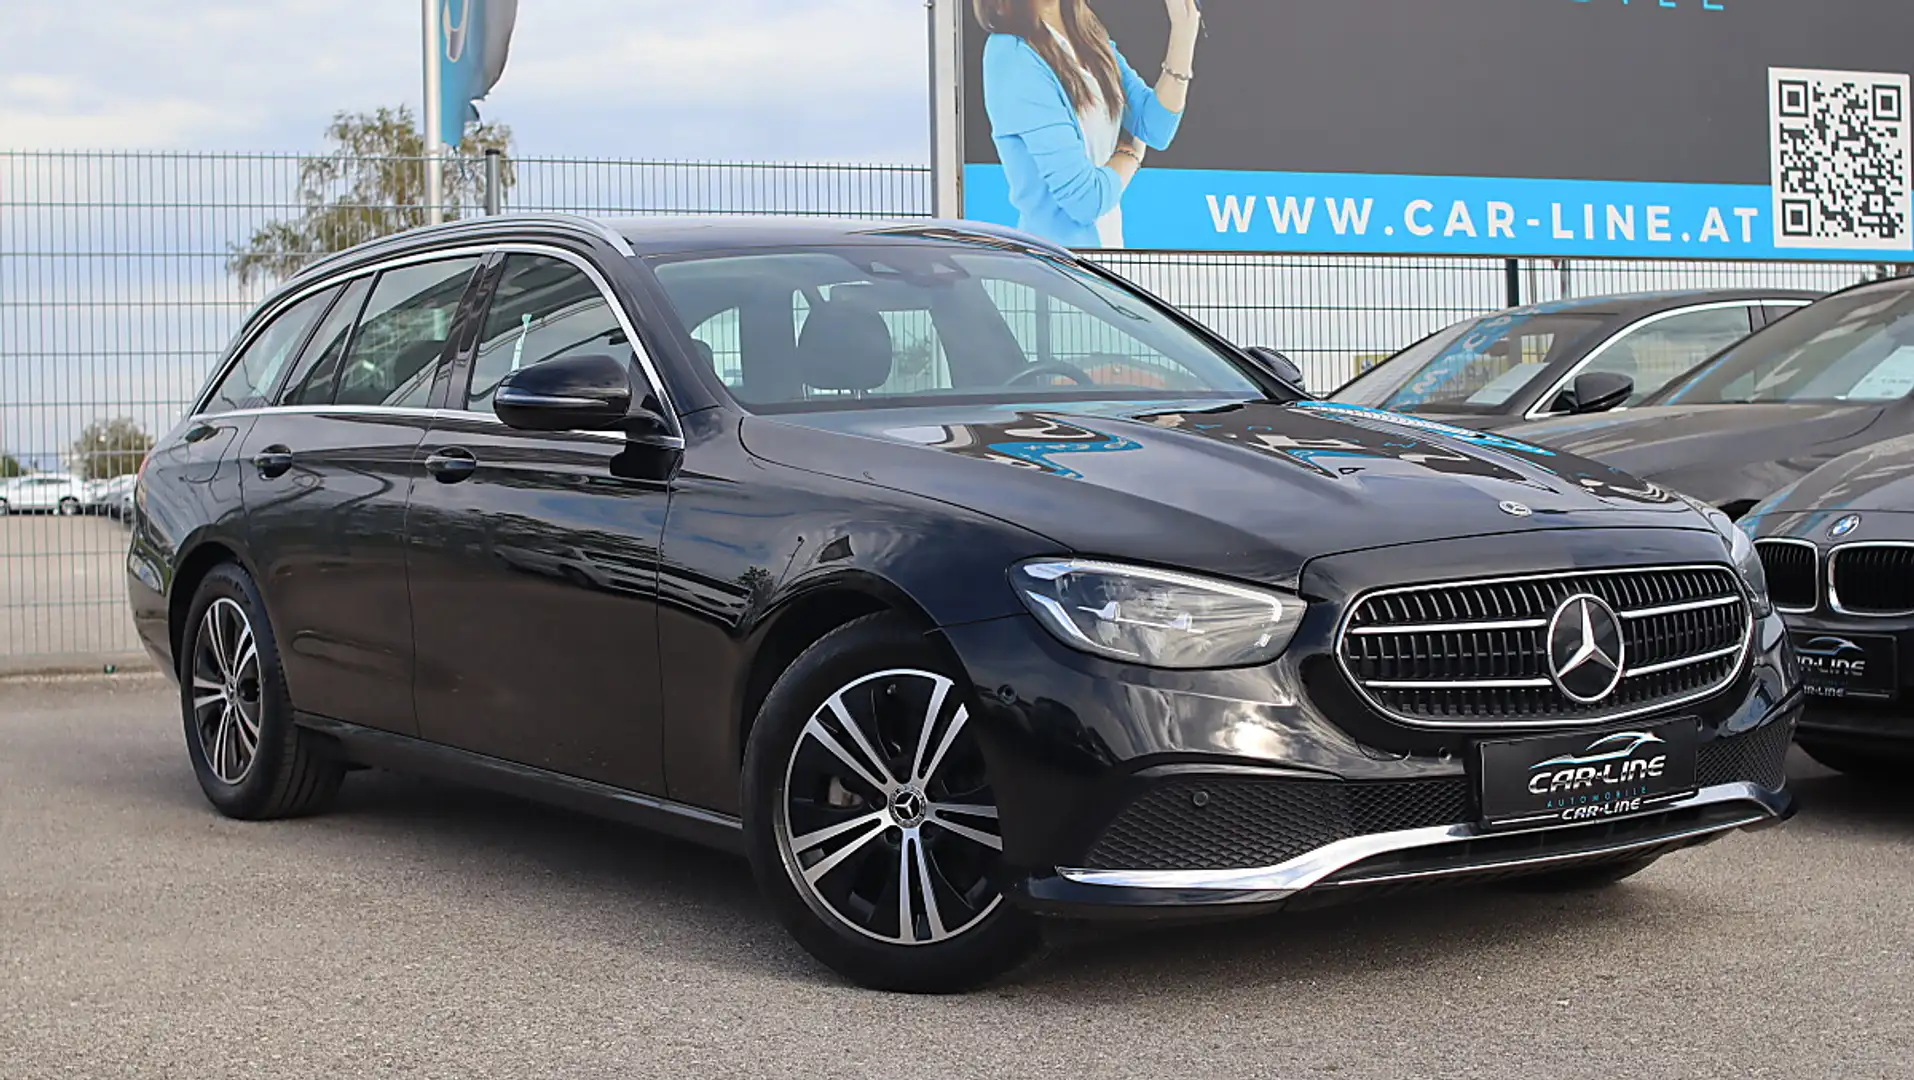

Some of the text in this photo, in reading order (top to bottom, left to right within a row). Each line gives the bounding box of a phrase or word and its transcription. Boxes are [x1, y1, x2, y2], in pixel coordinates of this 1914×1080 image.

[1205, 194, 1759, 243] WWW.CAR-LINE.AT
[1796, 655, 1866, 676] R-LINE
[1528, 754, 1666, 794] CAR-LINE
[1547, 786, 1647, 808] AUTOMOBILE
[1561, 797, 1641, 820] CAR-LINE
